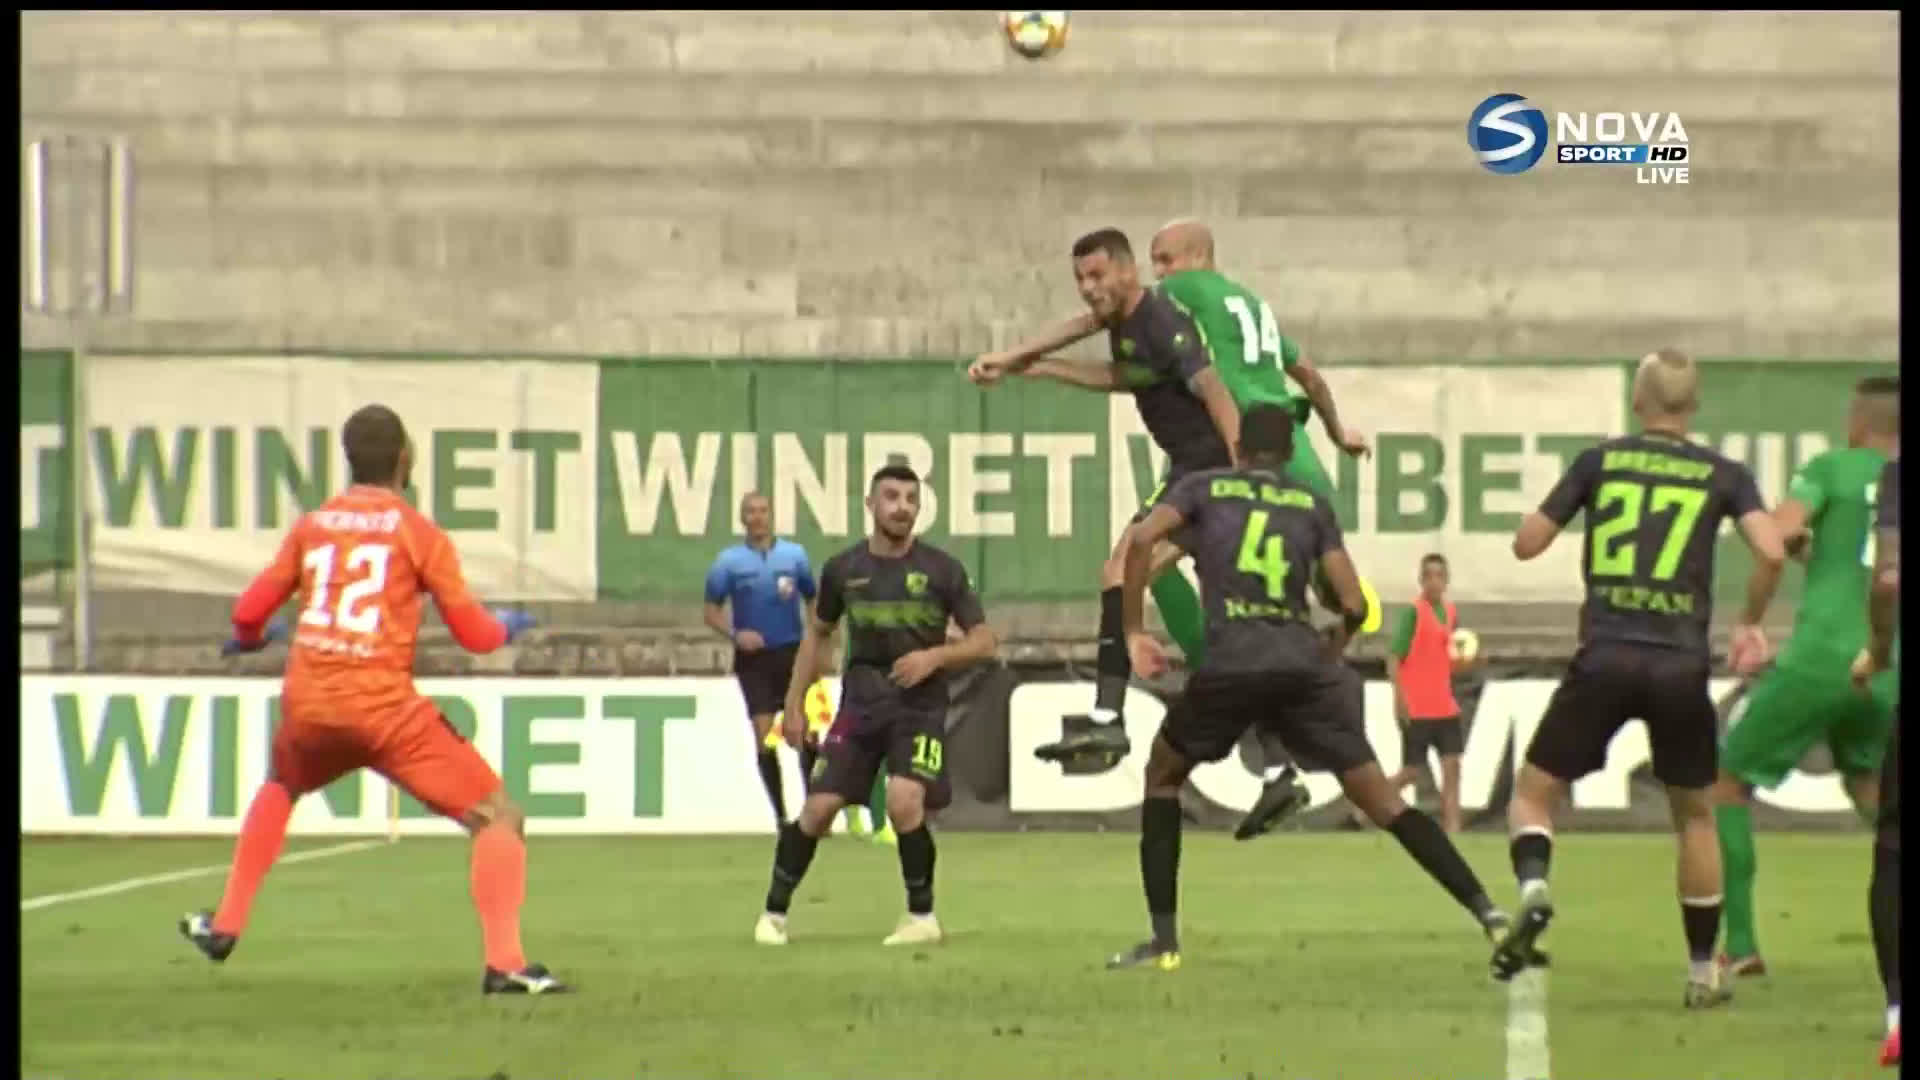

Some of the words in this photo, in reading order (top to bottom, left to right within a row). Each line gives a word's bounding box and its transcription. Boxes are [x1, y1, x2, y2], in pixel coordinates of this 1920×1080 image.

[1224, 295, 1284, 371] 14
[90, 426, 581, 531] WINET
[612, 432, 1097, 537] WINBET
[1237, 510, 1290, 599] 4
[1592, 482, 1708, 580] 27
[299, 543, 394, 633] 12
